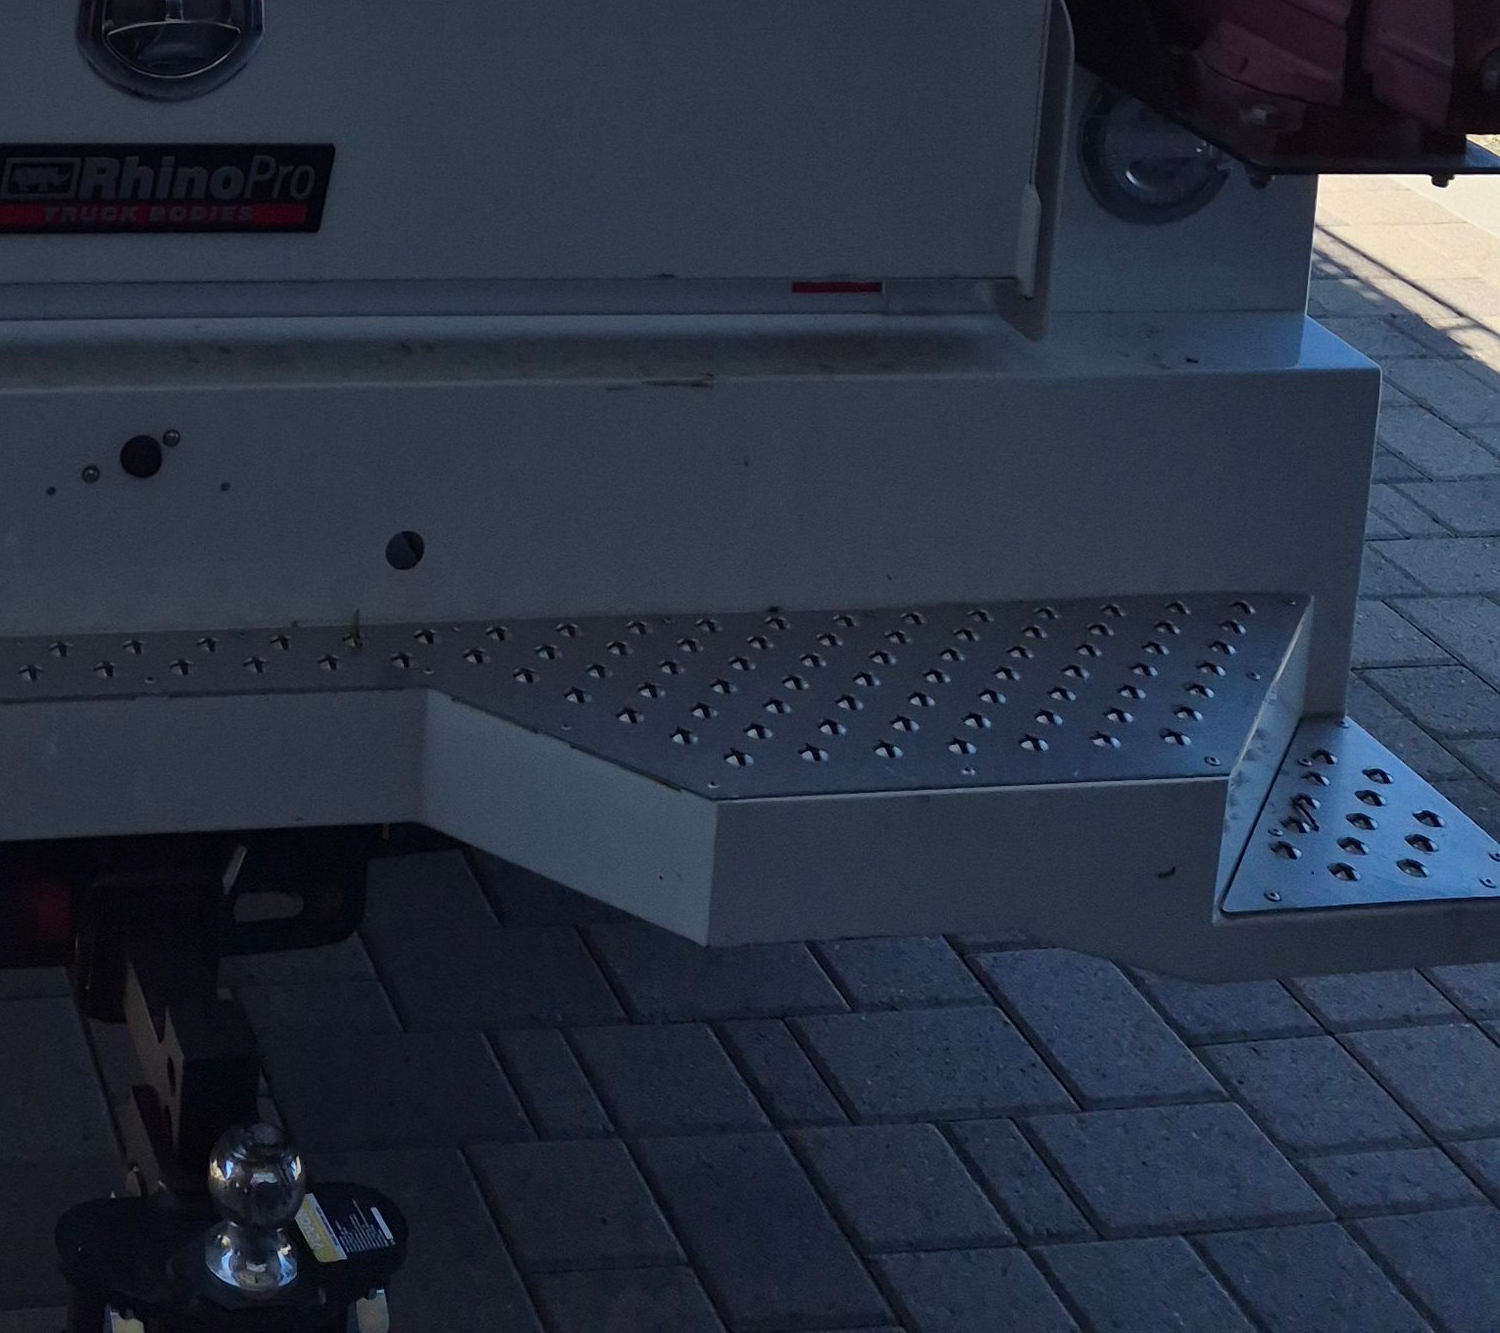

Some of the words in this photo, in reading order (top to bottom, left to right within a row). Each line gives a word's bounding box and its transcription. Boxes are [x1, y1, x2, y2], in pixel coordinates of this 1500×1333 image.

[80, 154, 316, 201] RhinoPro
[43, 205, 139, 223] TRUCK
[148, 204, 254, 222] BODIES
